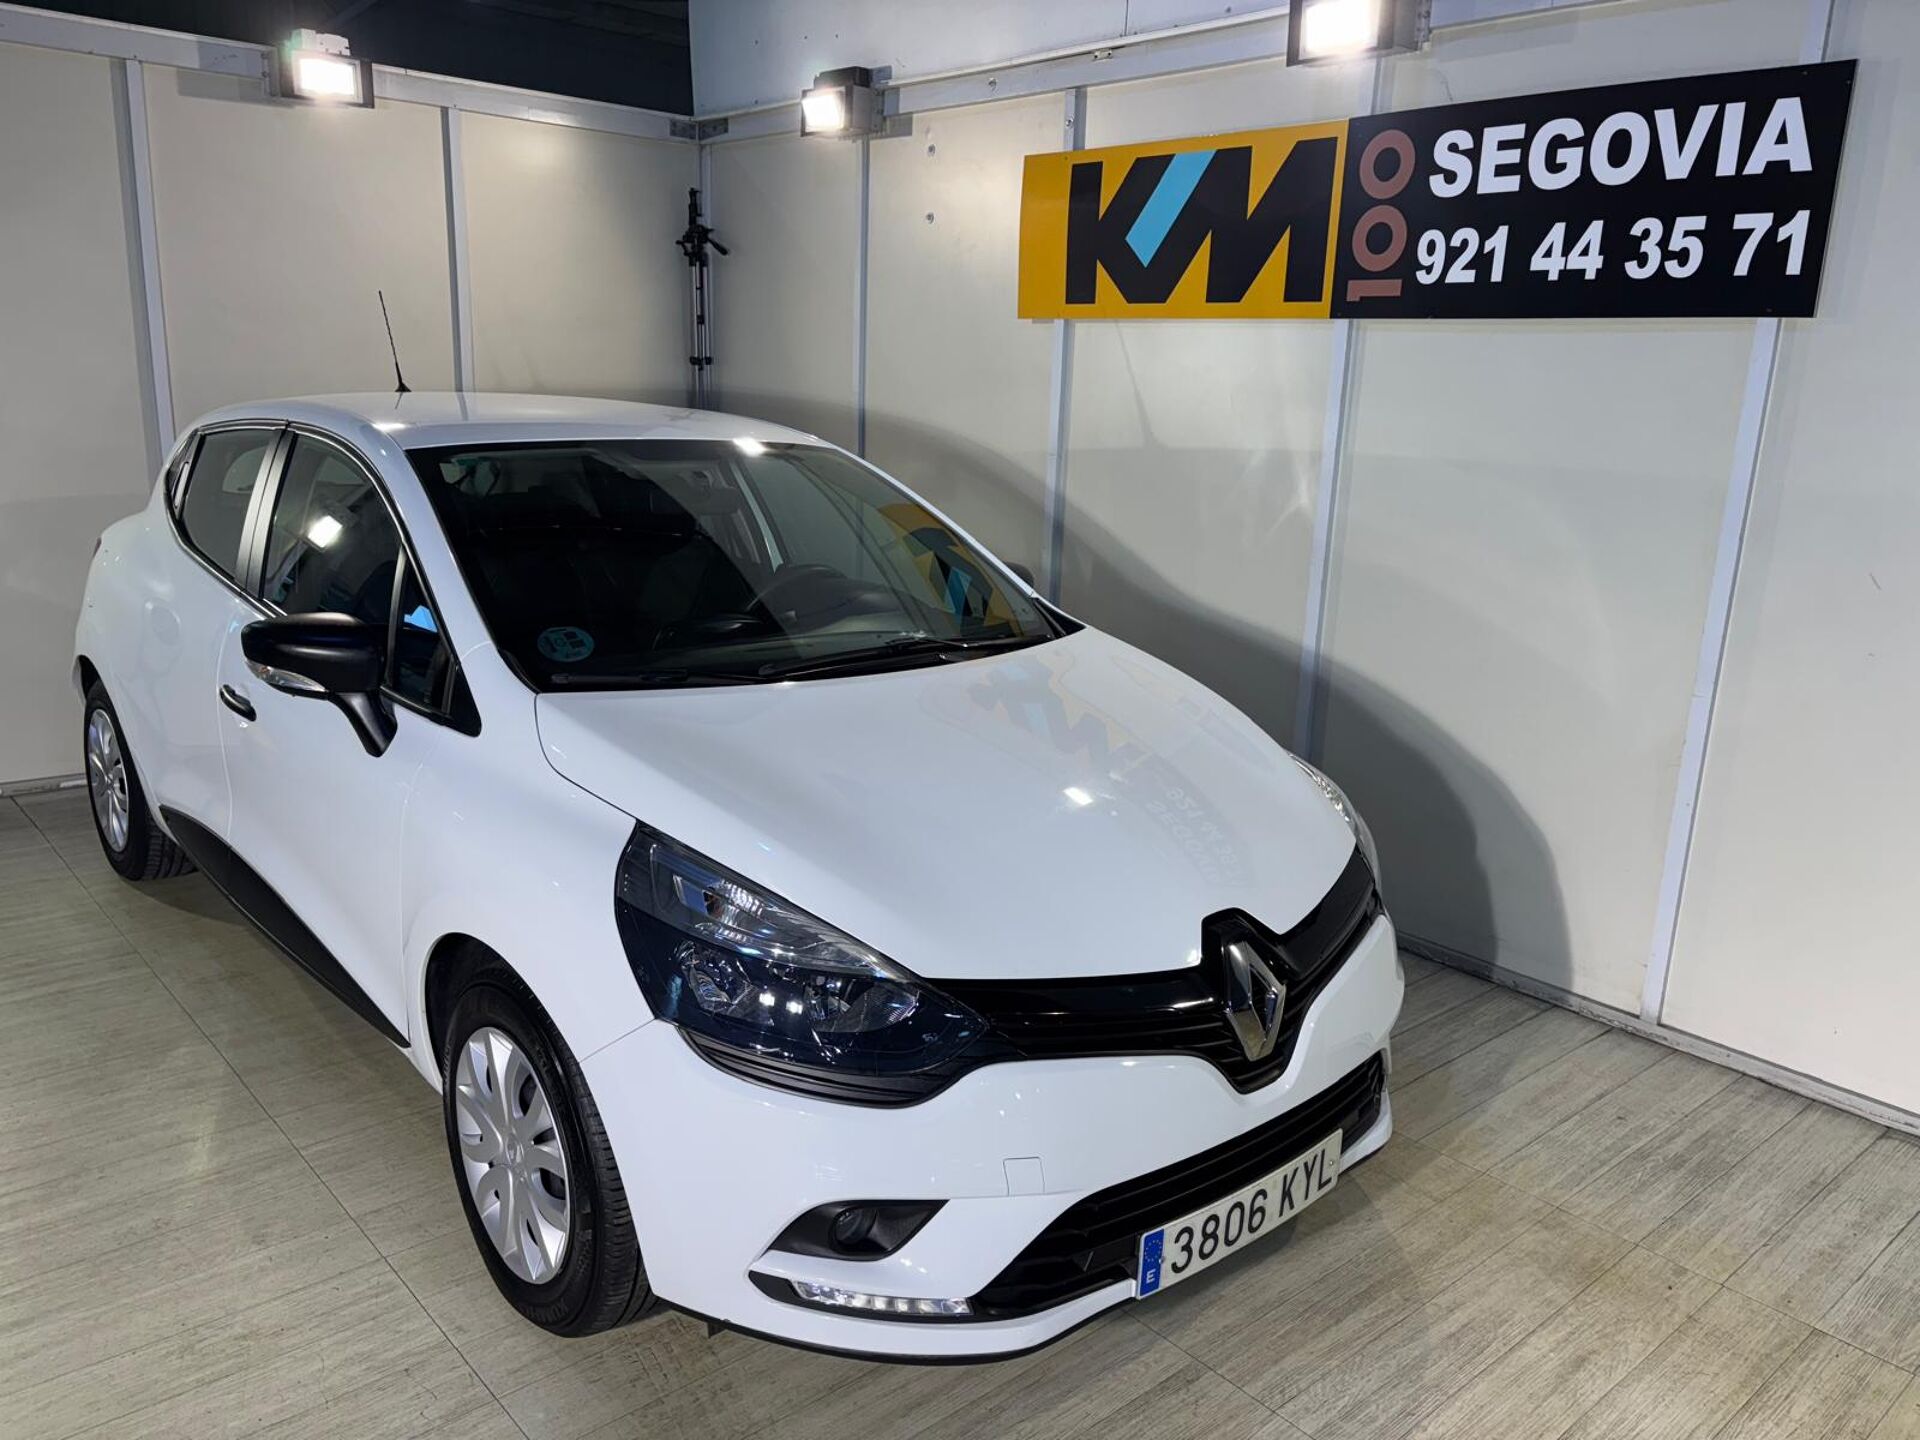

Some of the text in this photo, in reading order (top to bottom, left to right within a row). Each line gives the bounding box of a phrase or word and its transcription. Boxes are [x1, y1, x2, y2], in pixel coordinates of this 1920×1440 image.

[1428, 96, 1813, 198] SEGOVIA
[1065, 136, 1337, 305] KM
[1346, 129, 1416, 303] 100
[1415, 209, 1811, 285] 921 44 35 71
[1170, 1148, 1333, 1274] 3806 KYL
[1145, 1268, 1156, 1284] E
